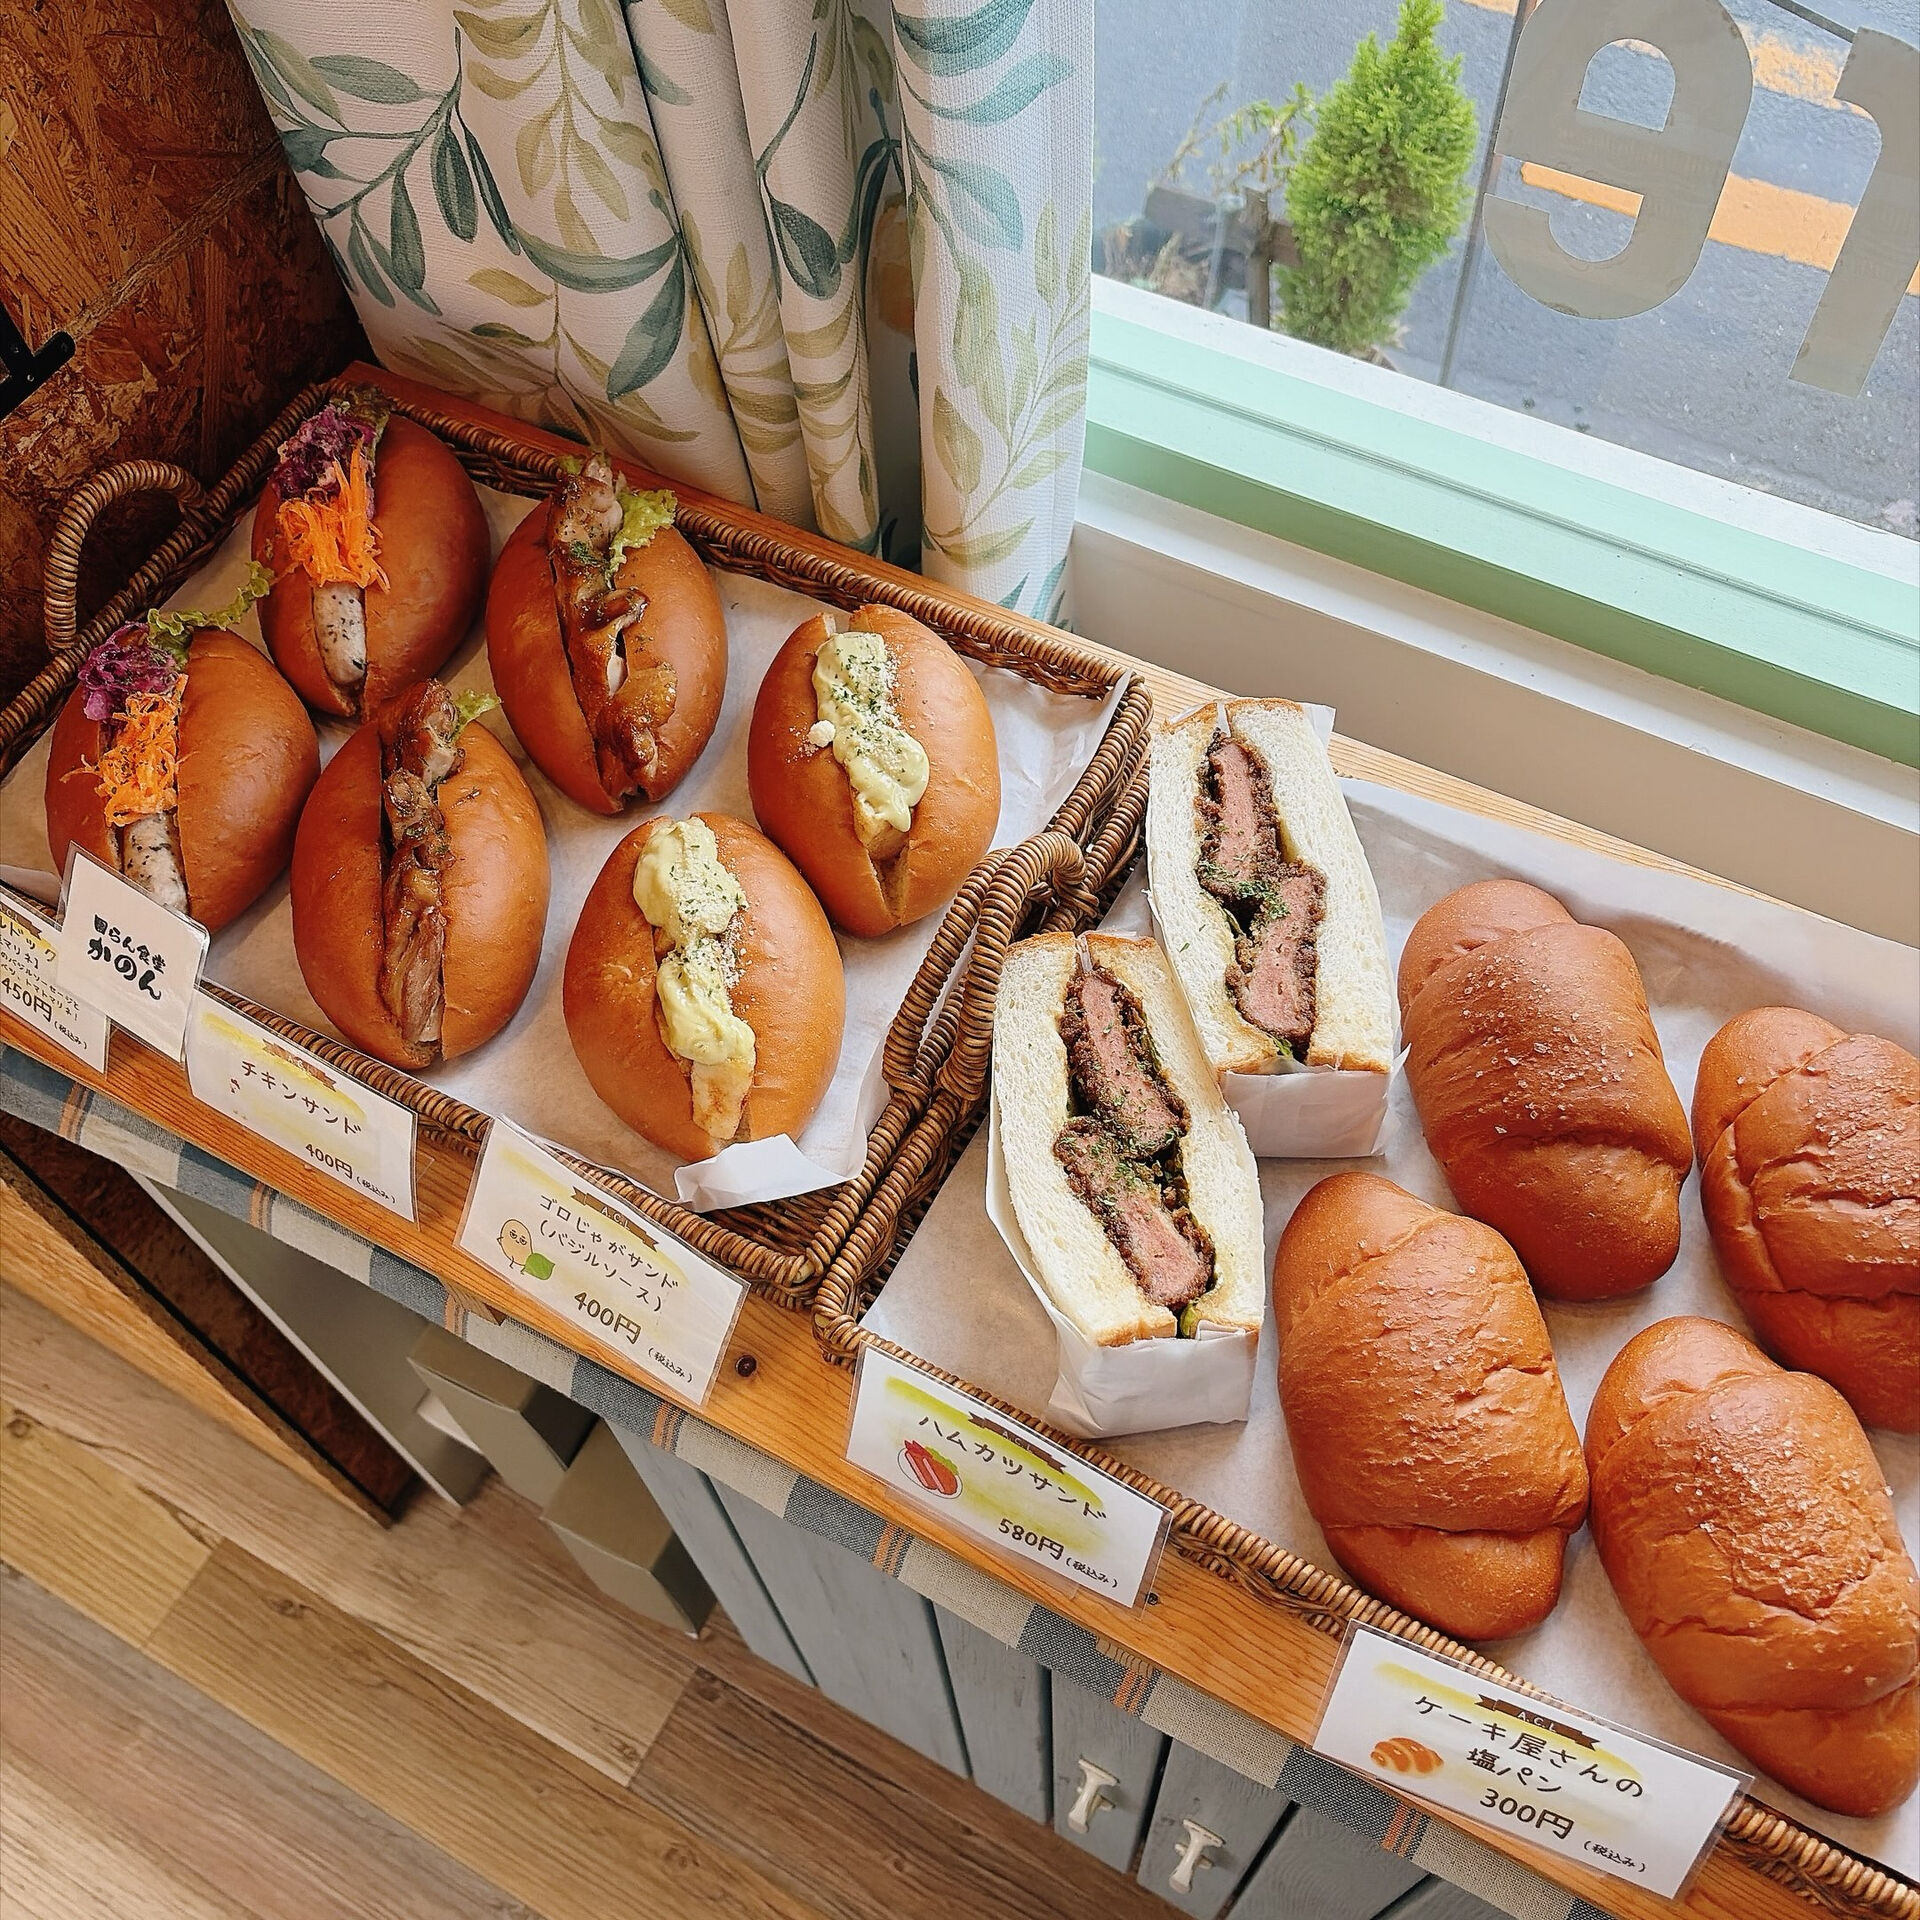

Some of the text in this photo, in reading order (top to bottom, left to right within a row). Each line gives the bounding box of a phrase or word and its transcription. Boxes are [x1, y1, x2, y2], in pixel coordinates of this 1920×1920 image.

[87, 936, 162, 1000] かのん
[2, 977, 52, 1022] 450円
[241, 1060, 362, 1135] チキンサンド
[305, 1143, 353, 1180] 400円
[539, 1194, 680, 1290] ゴロじゃがサンド
[539, 1219, 663, 1312] （バジルソース）
[574, 1291, 642, 1344] 400円
[918, 1416, 1107, 1521] ハムカツサンド
[998, 1518, 1065, 1561] 580円
[1414, 1695, 1645, 1799] ケーキ屋さんの
[1466, 1747, 1562, 1795] 塩パン
[1479, 1787, 1575, 1840] 300円
